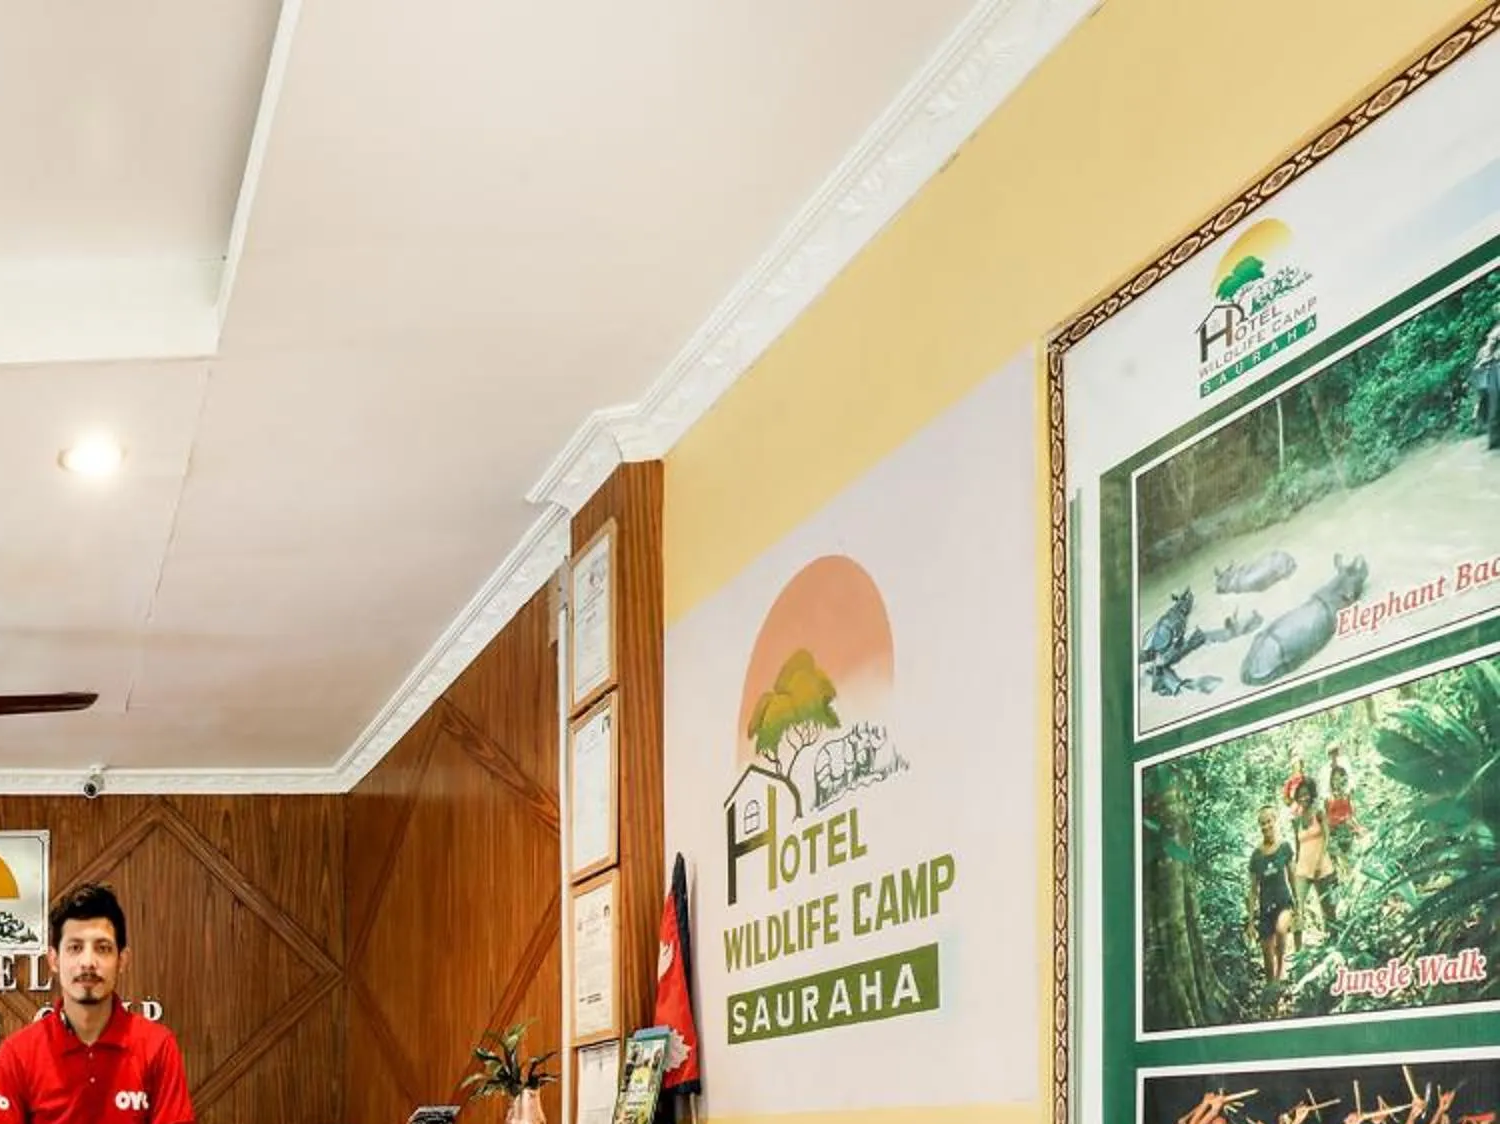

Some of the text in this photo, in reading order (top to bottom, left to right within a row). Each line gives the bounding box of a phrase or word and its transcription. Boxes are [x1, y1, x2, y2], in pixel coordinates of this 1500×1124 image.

[1200, 305, 1281, 363] HOTEL
[1272, 296, 1317, 333] CAMP
[1203, 318, 1315, 395] SAURAHA
[1337, 575, 1447, 638] Elephant
[727, 784, 868, 907] HOTEL
[723, 853, 956, 974] WILDLIFE CAMP
[732, 962, 921, 1036] SAURAHA
[1332, 949, 1487, 997] Jungle Walk
